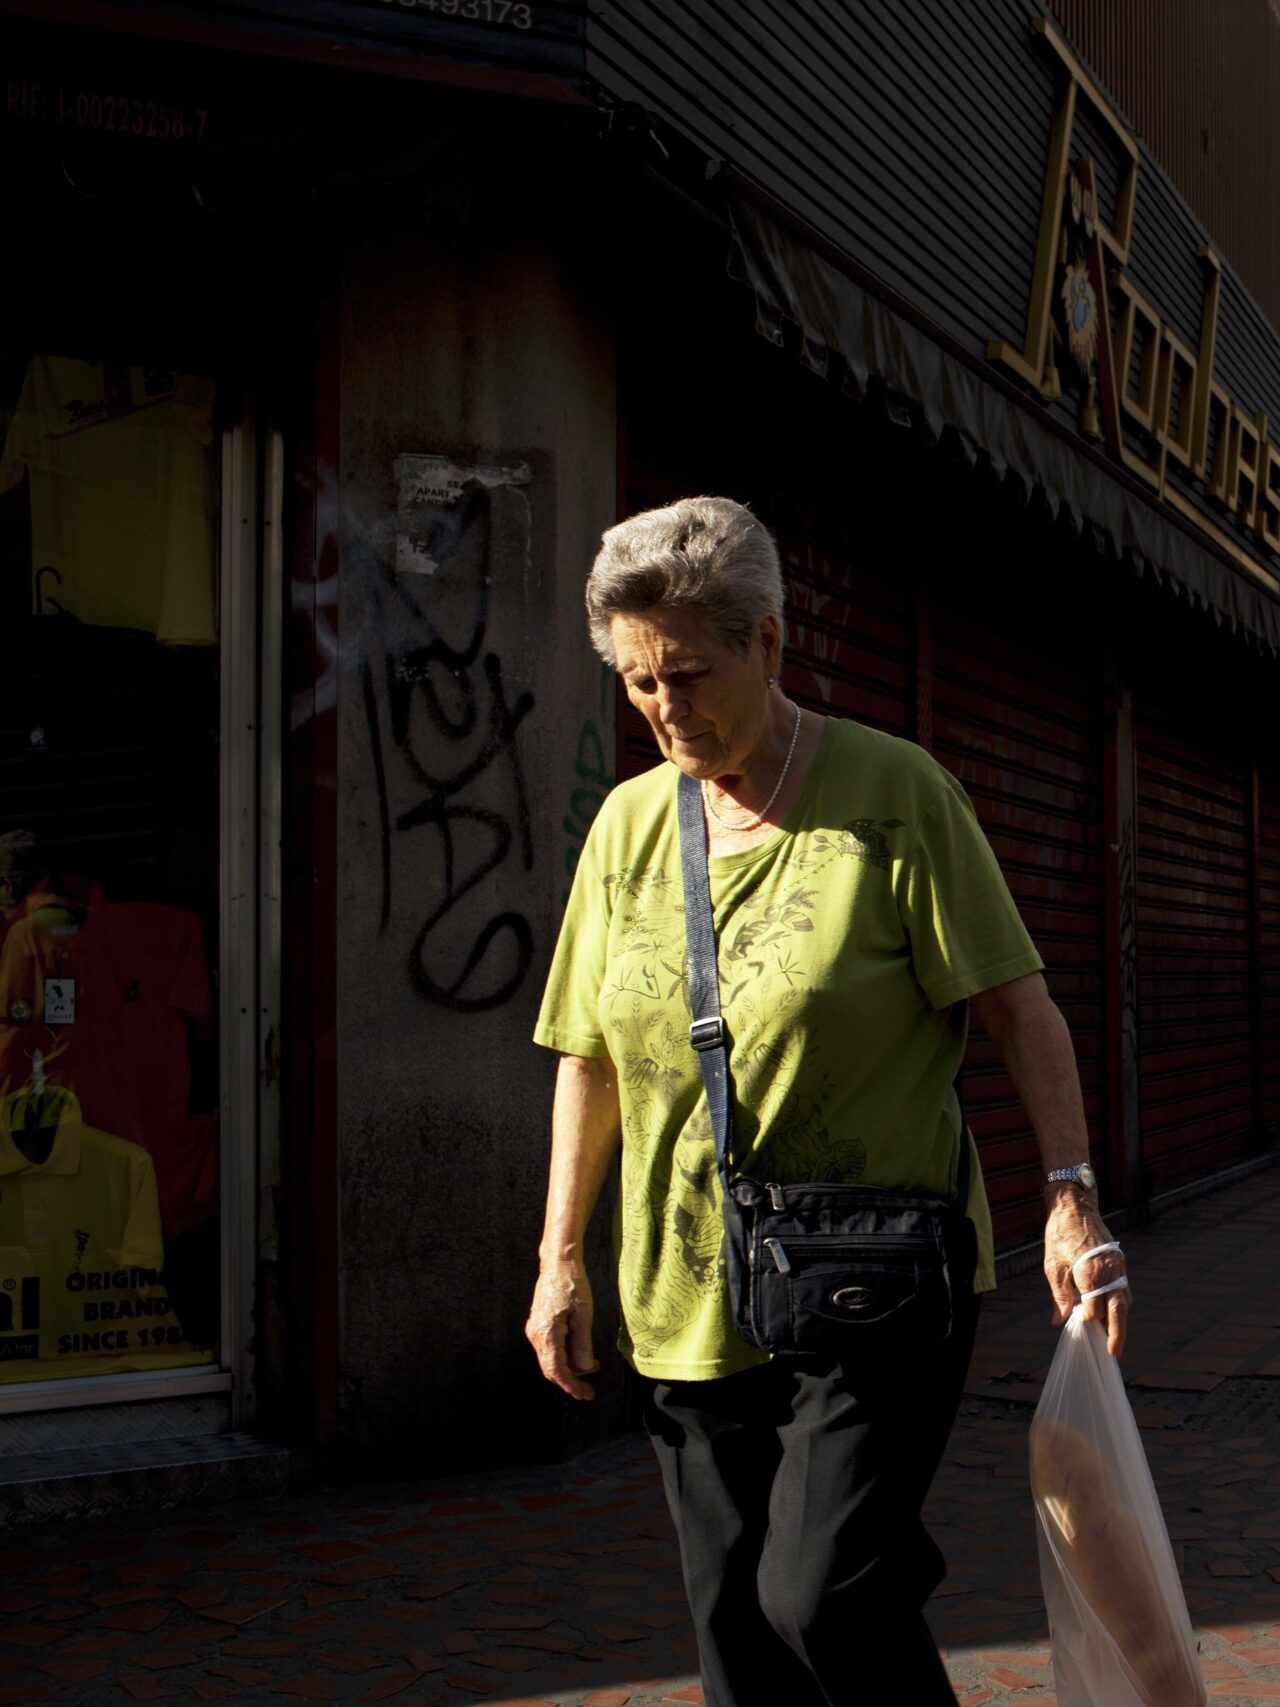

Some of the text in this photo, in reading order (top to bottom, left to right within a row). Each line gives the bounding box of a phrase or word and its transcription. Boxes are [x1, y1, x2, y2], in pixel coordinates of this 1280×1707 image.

[378, 0, 533, 30] 93173
[66, 1267, 166, 1292] ORIGIN
[84, 1297, 171, 1321] BRAND
[57, 1326, 183, 1354] SINCE 198
